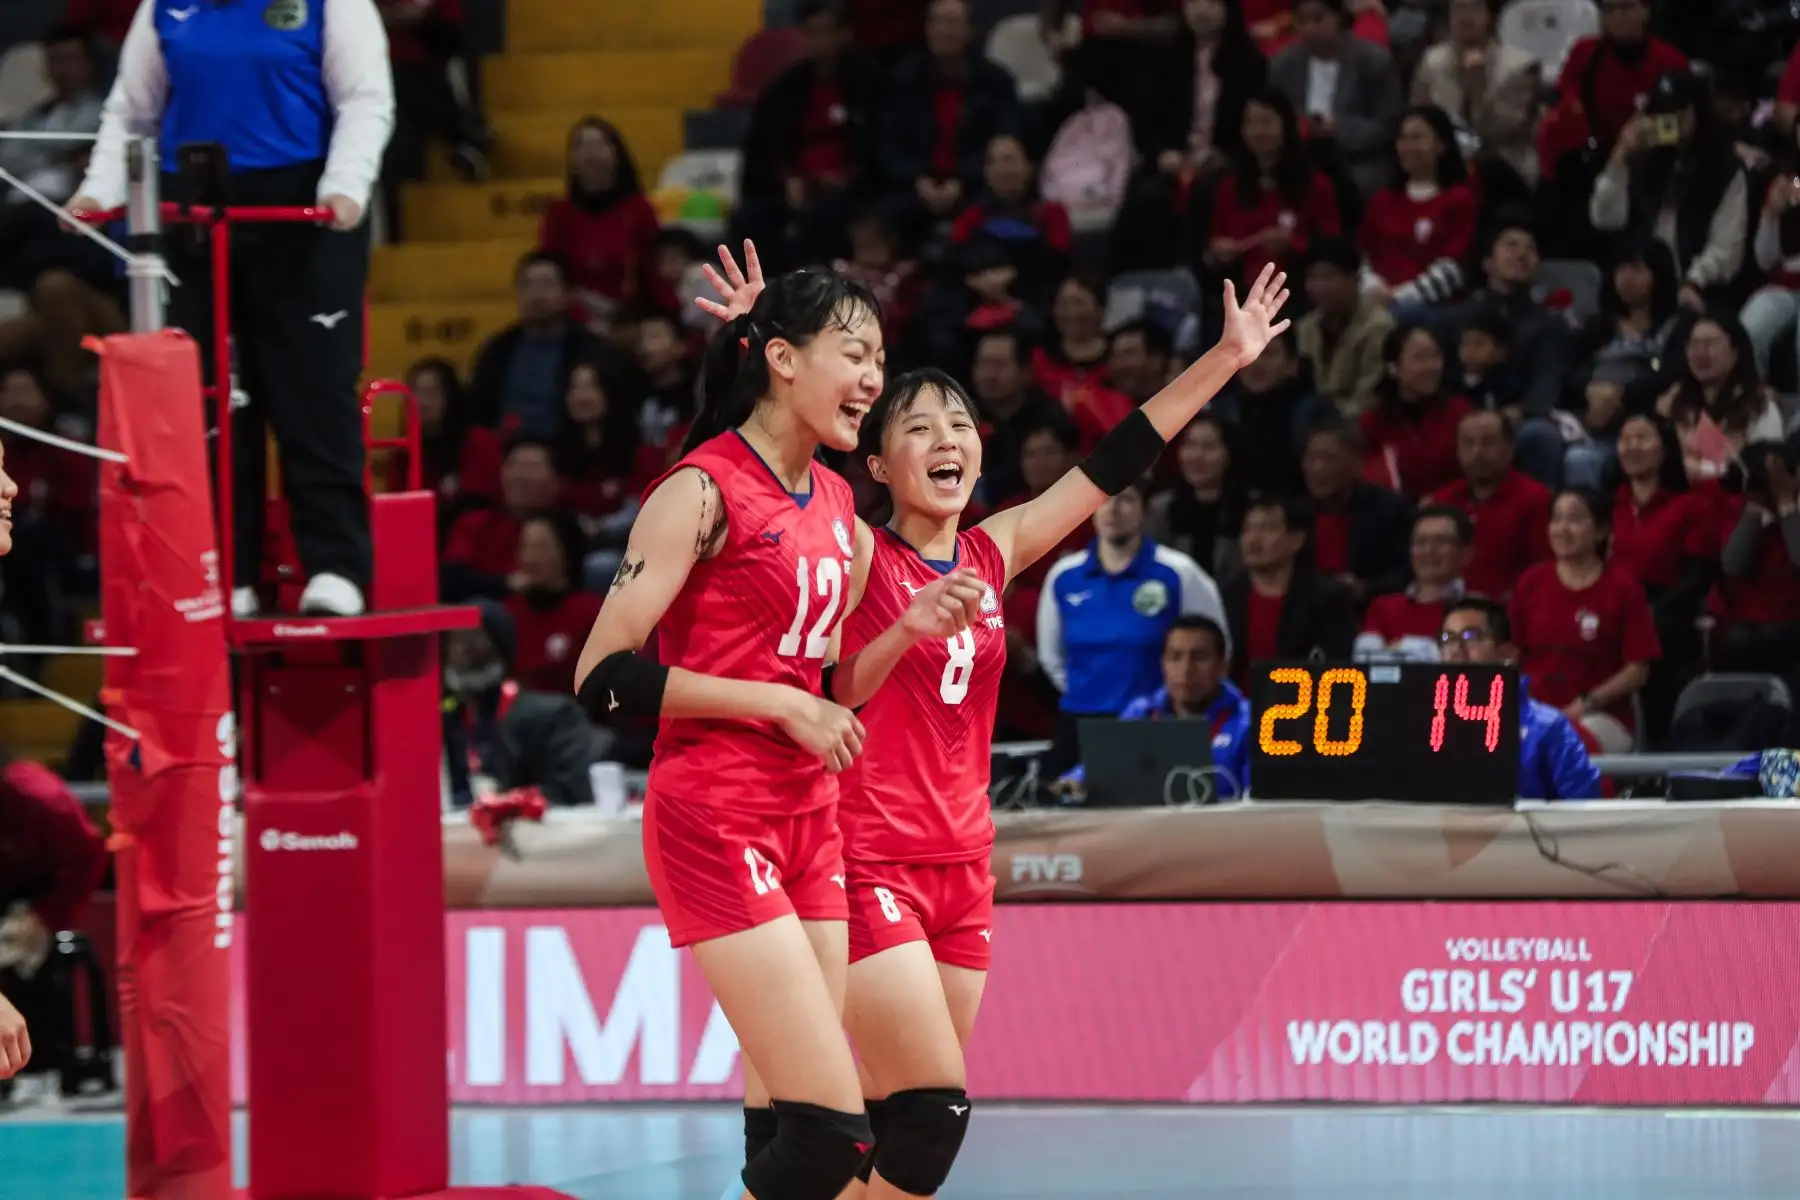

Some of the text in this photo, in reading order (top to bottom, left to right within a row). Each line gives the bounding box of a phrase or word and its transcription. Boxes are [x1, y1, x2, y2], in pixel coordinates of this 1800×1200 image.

[777, 556, 842, 659] 12
[985, 616, 1005, 630] TPE
[940, 624, 976, 705] 8
[1258, 668, 1504, 756] 20 14
[873, 886, 902, 923] 8
[1445, 937, 1592, 962] VOLLEYBALL
[1400, 967, 1634, 1014] GIRLS' U17
[1286, 1019, 1755, 1067] WORLD CHAMPIONSHIP
